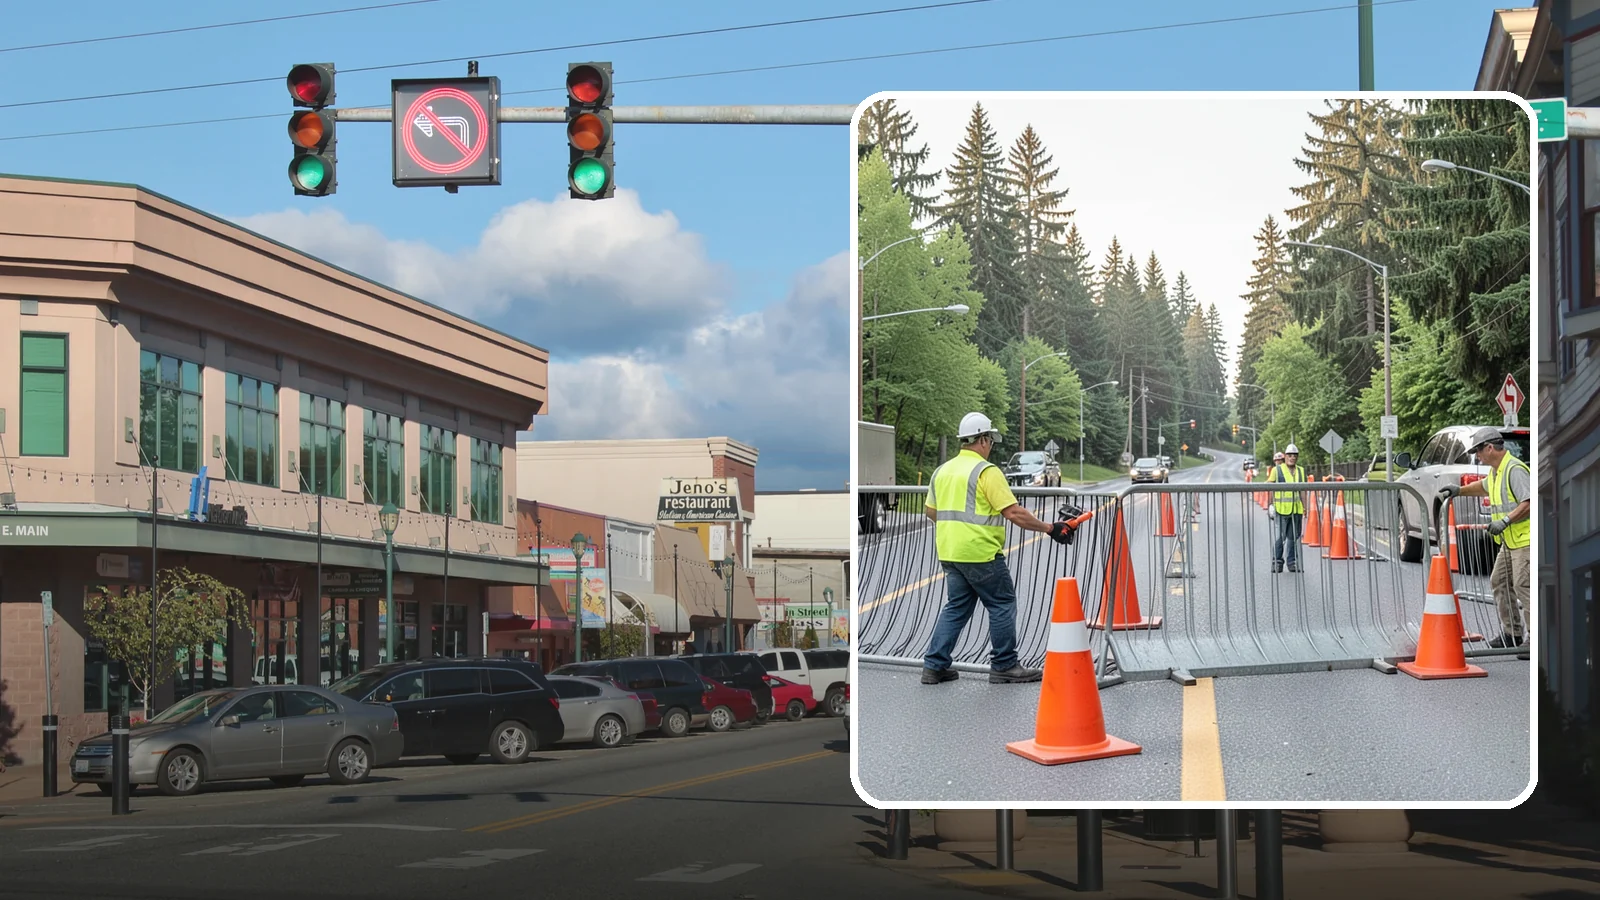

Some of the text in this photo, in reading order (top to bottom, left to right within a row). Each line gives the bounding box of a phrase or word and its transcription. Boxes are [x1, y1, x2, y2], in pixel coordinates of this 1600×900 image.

[670, 480, 727, 494] Jeno's
[665, 497, 731, 509] restaurant
[658, 510, 681, 519] Italian
[686, 510, 714, 519] American
[715, 510, 737, 519] Cuisine
[2, 525, 49, 536] E. MAIN
[797, 607, 828, 617] Street
